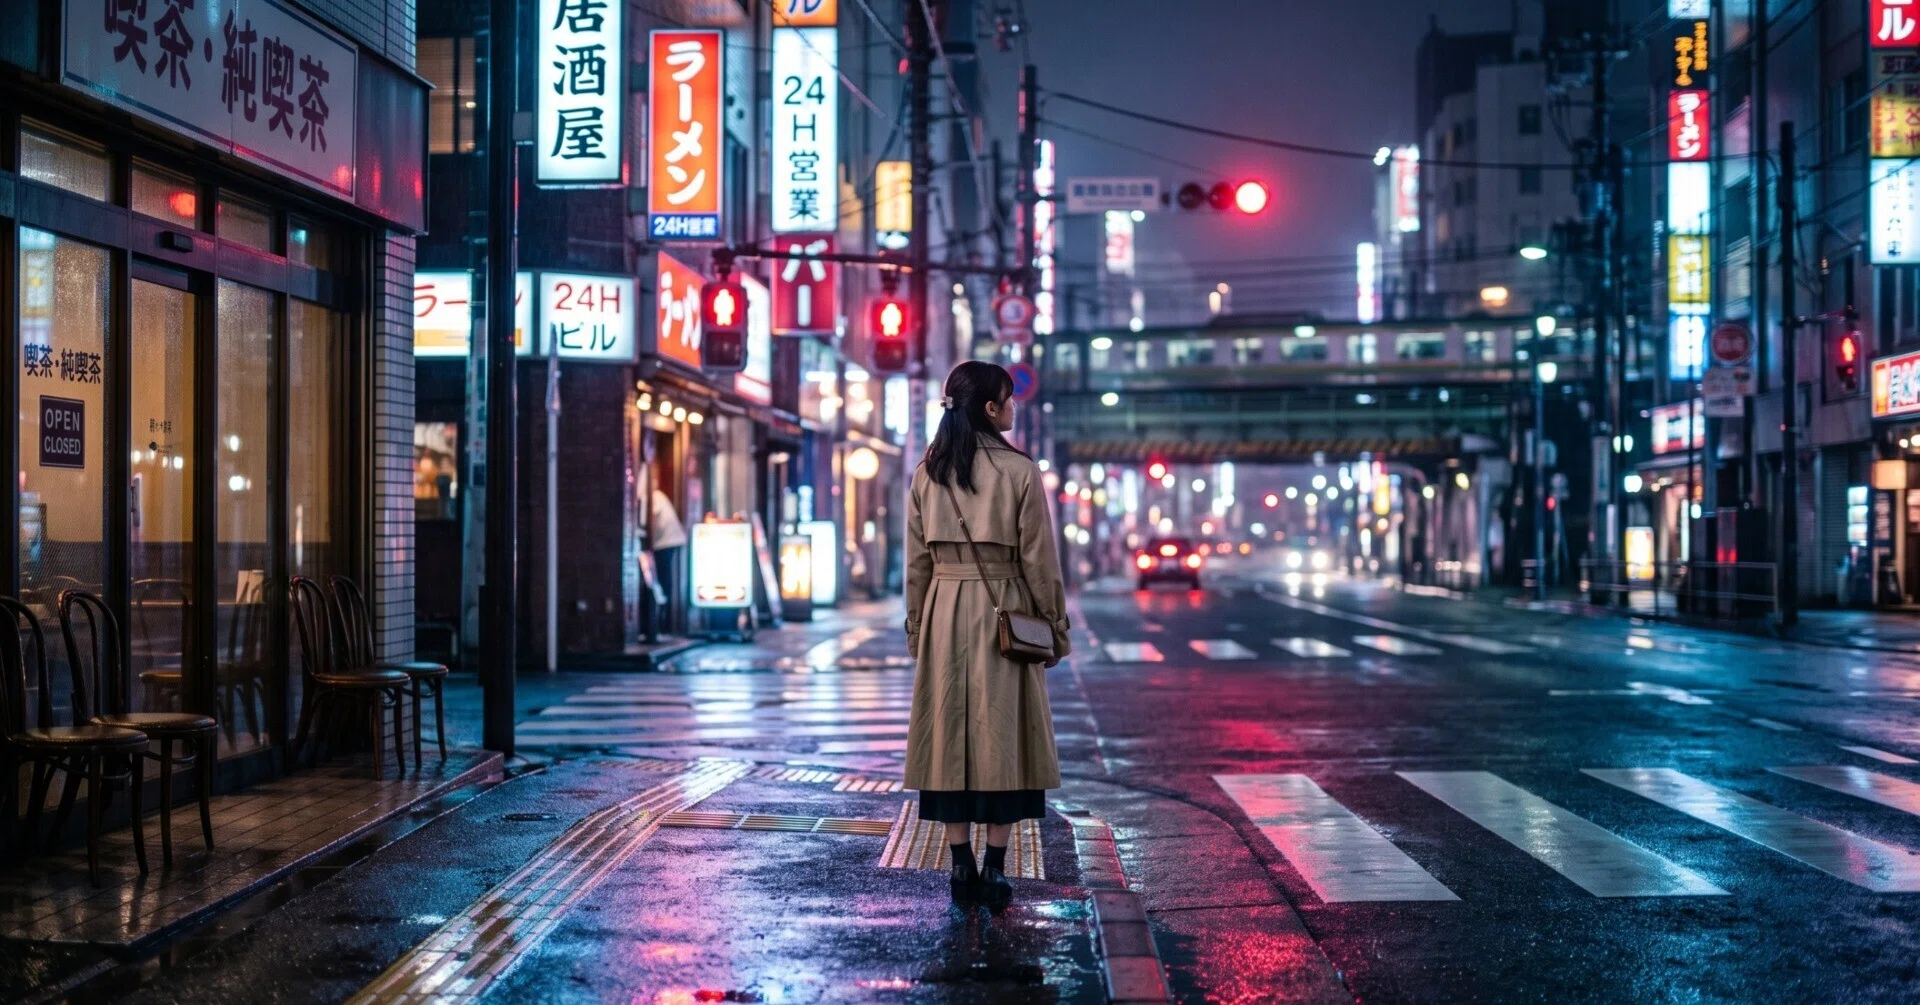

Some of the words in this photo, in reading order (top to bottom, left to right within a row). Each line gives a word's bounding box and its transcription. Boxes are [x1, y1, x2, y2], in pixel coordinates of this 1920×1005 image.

[104, 0, 329, 153] 喫茶・純喫茶
[550, 0, 608, 160] 居酒屋
[664, 41, 706, 205] ラーメン
[783, 75, 825, 221] 24H営業
[654, 216, 716, 236] 24H営業
[555, 282, 620, 313] 24H
[781, 239, 828, 326] バー
[560, 321, 616, 350] ビル
[24, 343, 101, 384] 喫茶・純喫茶
[45, 408, 80, 431] OPEN
[44, 436, 81, 455] CLOSED
